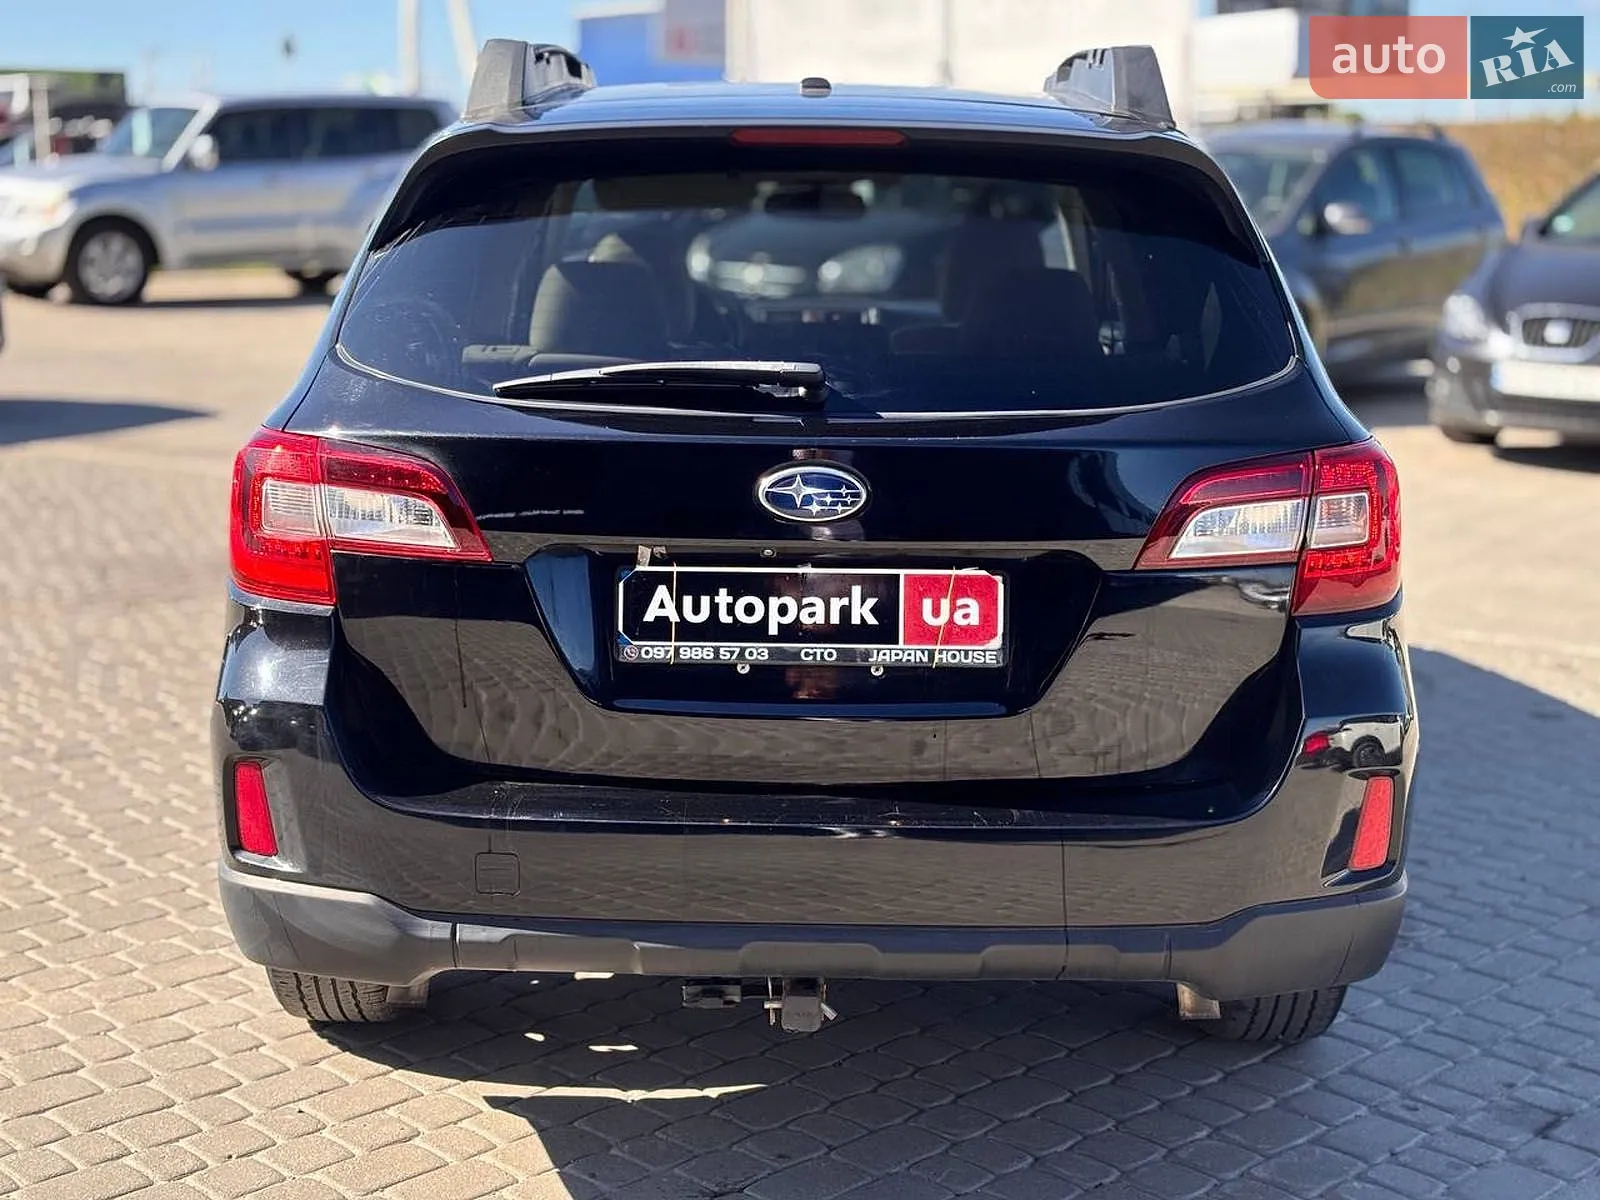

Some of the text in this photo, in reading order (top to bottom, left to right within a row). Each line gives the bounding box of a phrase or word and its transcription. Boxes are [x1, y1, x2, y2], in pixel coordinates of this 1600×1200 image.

[642, 584, 880, 636] Autopark
[921, 595, 980, 627] ua
[640, 646, 770, 661] 097 986 57 03
[868, 649, 998, 665] JAPAN HOUSE
